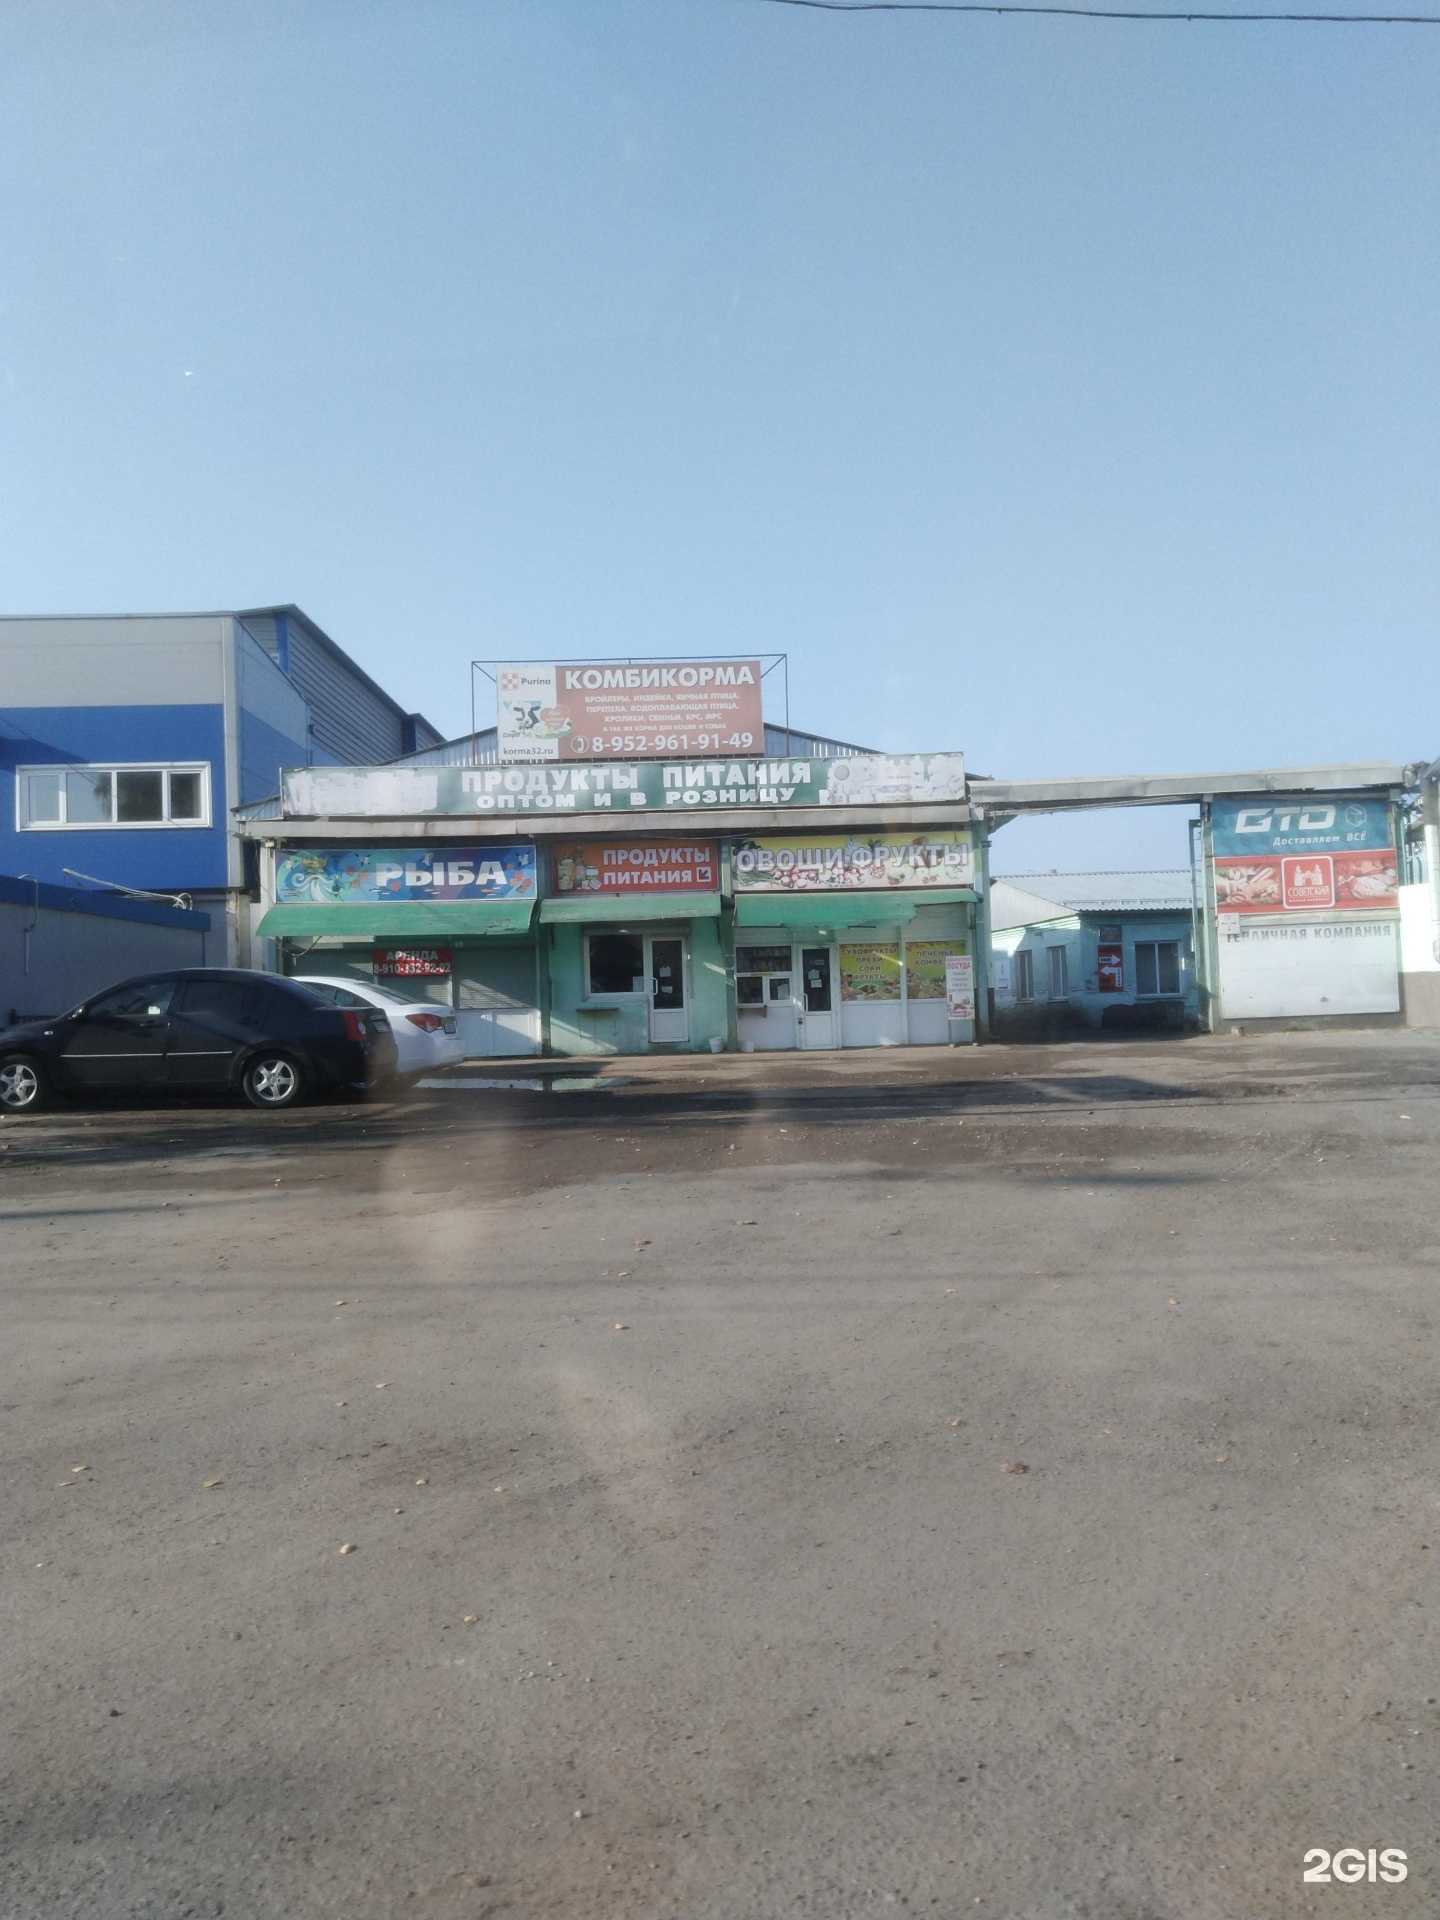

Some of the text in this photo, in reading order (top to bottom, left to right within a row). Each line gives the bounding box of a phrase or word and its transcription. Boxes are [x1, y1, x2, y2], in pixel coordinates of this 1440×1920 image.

[521, 677, 551, 685] Purina
[564, 666, 755, 689] КОМБИКОРМА
[503, 746, 554, 756] korma32.ru
[591, 732, 753, 752] 8-952-961-91-49
[461, 762, 811, 793] ПРОДУКТЫ ПИТАНИЯ
[476, 787, 796, 809] ОПТОМ И В РОЗНИЦУ
[603, 847, 711, 866] ПРОДУКТЫ
[851, 843, 969, 869] ФРУКТЫ
[375, 861, 508, 886] РЫБА
[603, 870, 692, 885] ПИТАНИЯ
[1314, 925, 1392, 938] КОМПАНИЯ
[387, 950, 439, 961] АРЕНДА
